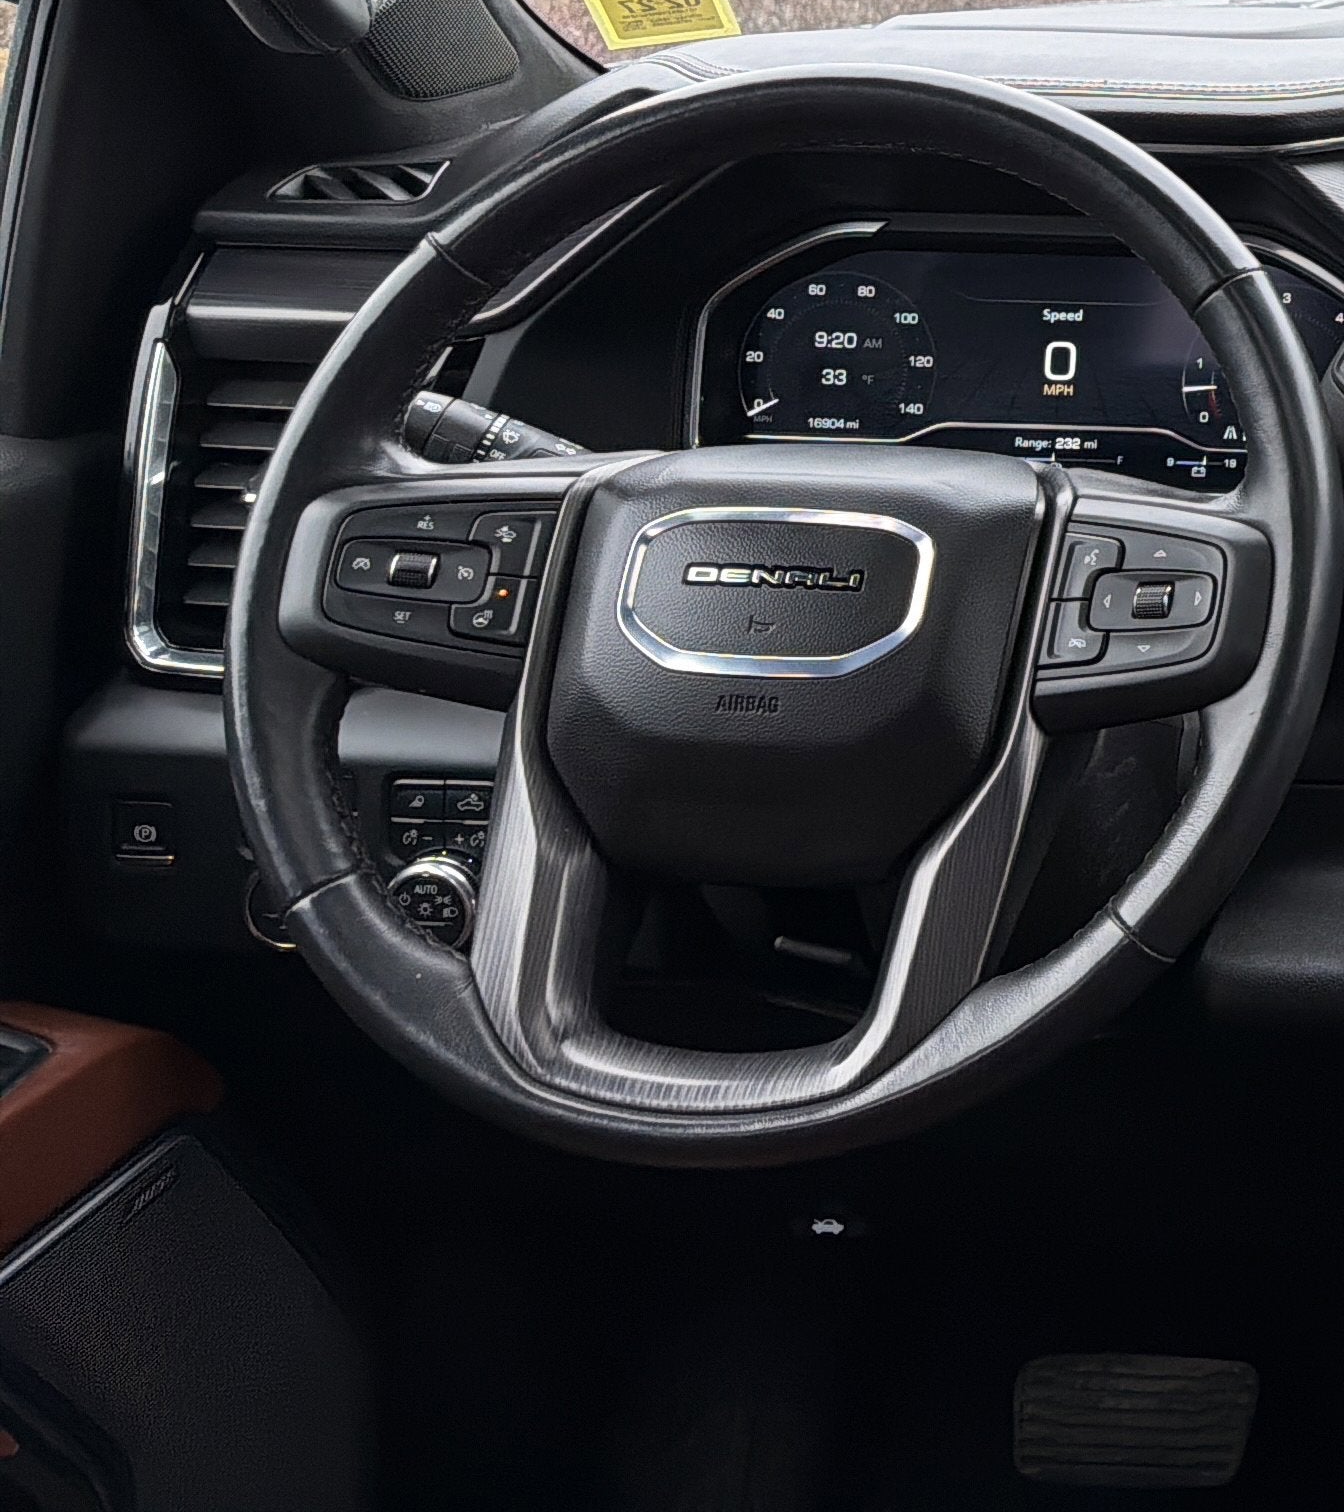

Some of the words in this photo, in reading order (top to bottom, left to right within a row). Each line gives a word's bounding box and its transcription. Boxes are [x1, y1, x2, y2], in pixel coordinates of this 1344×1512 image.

[808, 284, 826, 296] 60
[857, 285, 875, 297] 80
[1282, 292, 1292, 304] 3
[767, 308, 785, 320] 40
[893, 313, 919, 325] 100
[1042, 308, 1084, 323] Speed
[1334, 312, 1344, 324] 4
[814, 331, 858, 349] 9:20
[863, 338, 883, 349] AM
[746, 351, 764, 363] 20
[908, 356, 934, 368] 120
[1044, 341, 1077, 381] 0
[1197, 357, 1204, 369] 1
[821, 369, 847, 386] 33
[1043, 384, 1074, 396] MPH
[899, 403, 924, 415] 140
[808, 417, 845, 429] 16904
[846, 419, 860, 429] mi
[1199, 411, 1209, 423] 0
[1015, 437, 1052, 451] Range:
[1055, 438, 1081, 449] 232
[1084, 439, 1098, 449] mi
[489, 448, 506, 461] OFF
[1116, 456, 1124, 466] F
[416, 520, 434, 531] RES
[684, 564, 863, 589] DENALI
[393, 610, 412, 621] SET
[715, 695, 779, 714] AIRBAG
[413, 884, 438, 896] AUTO
